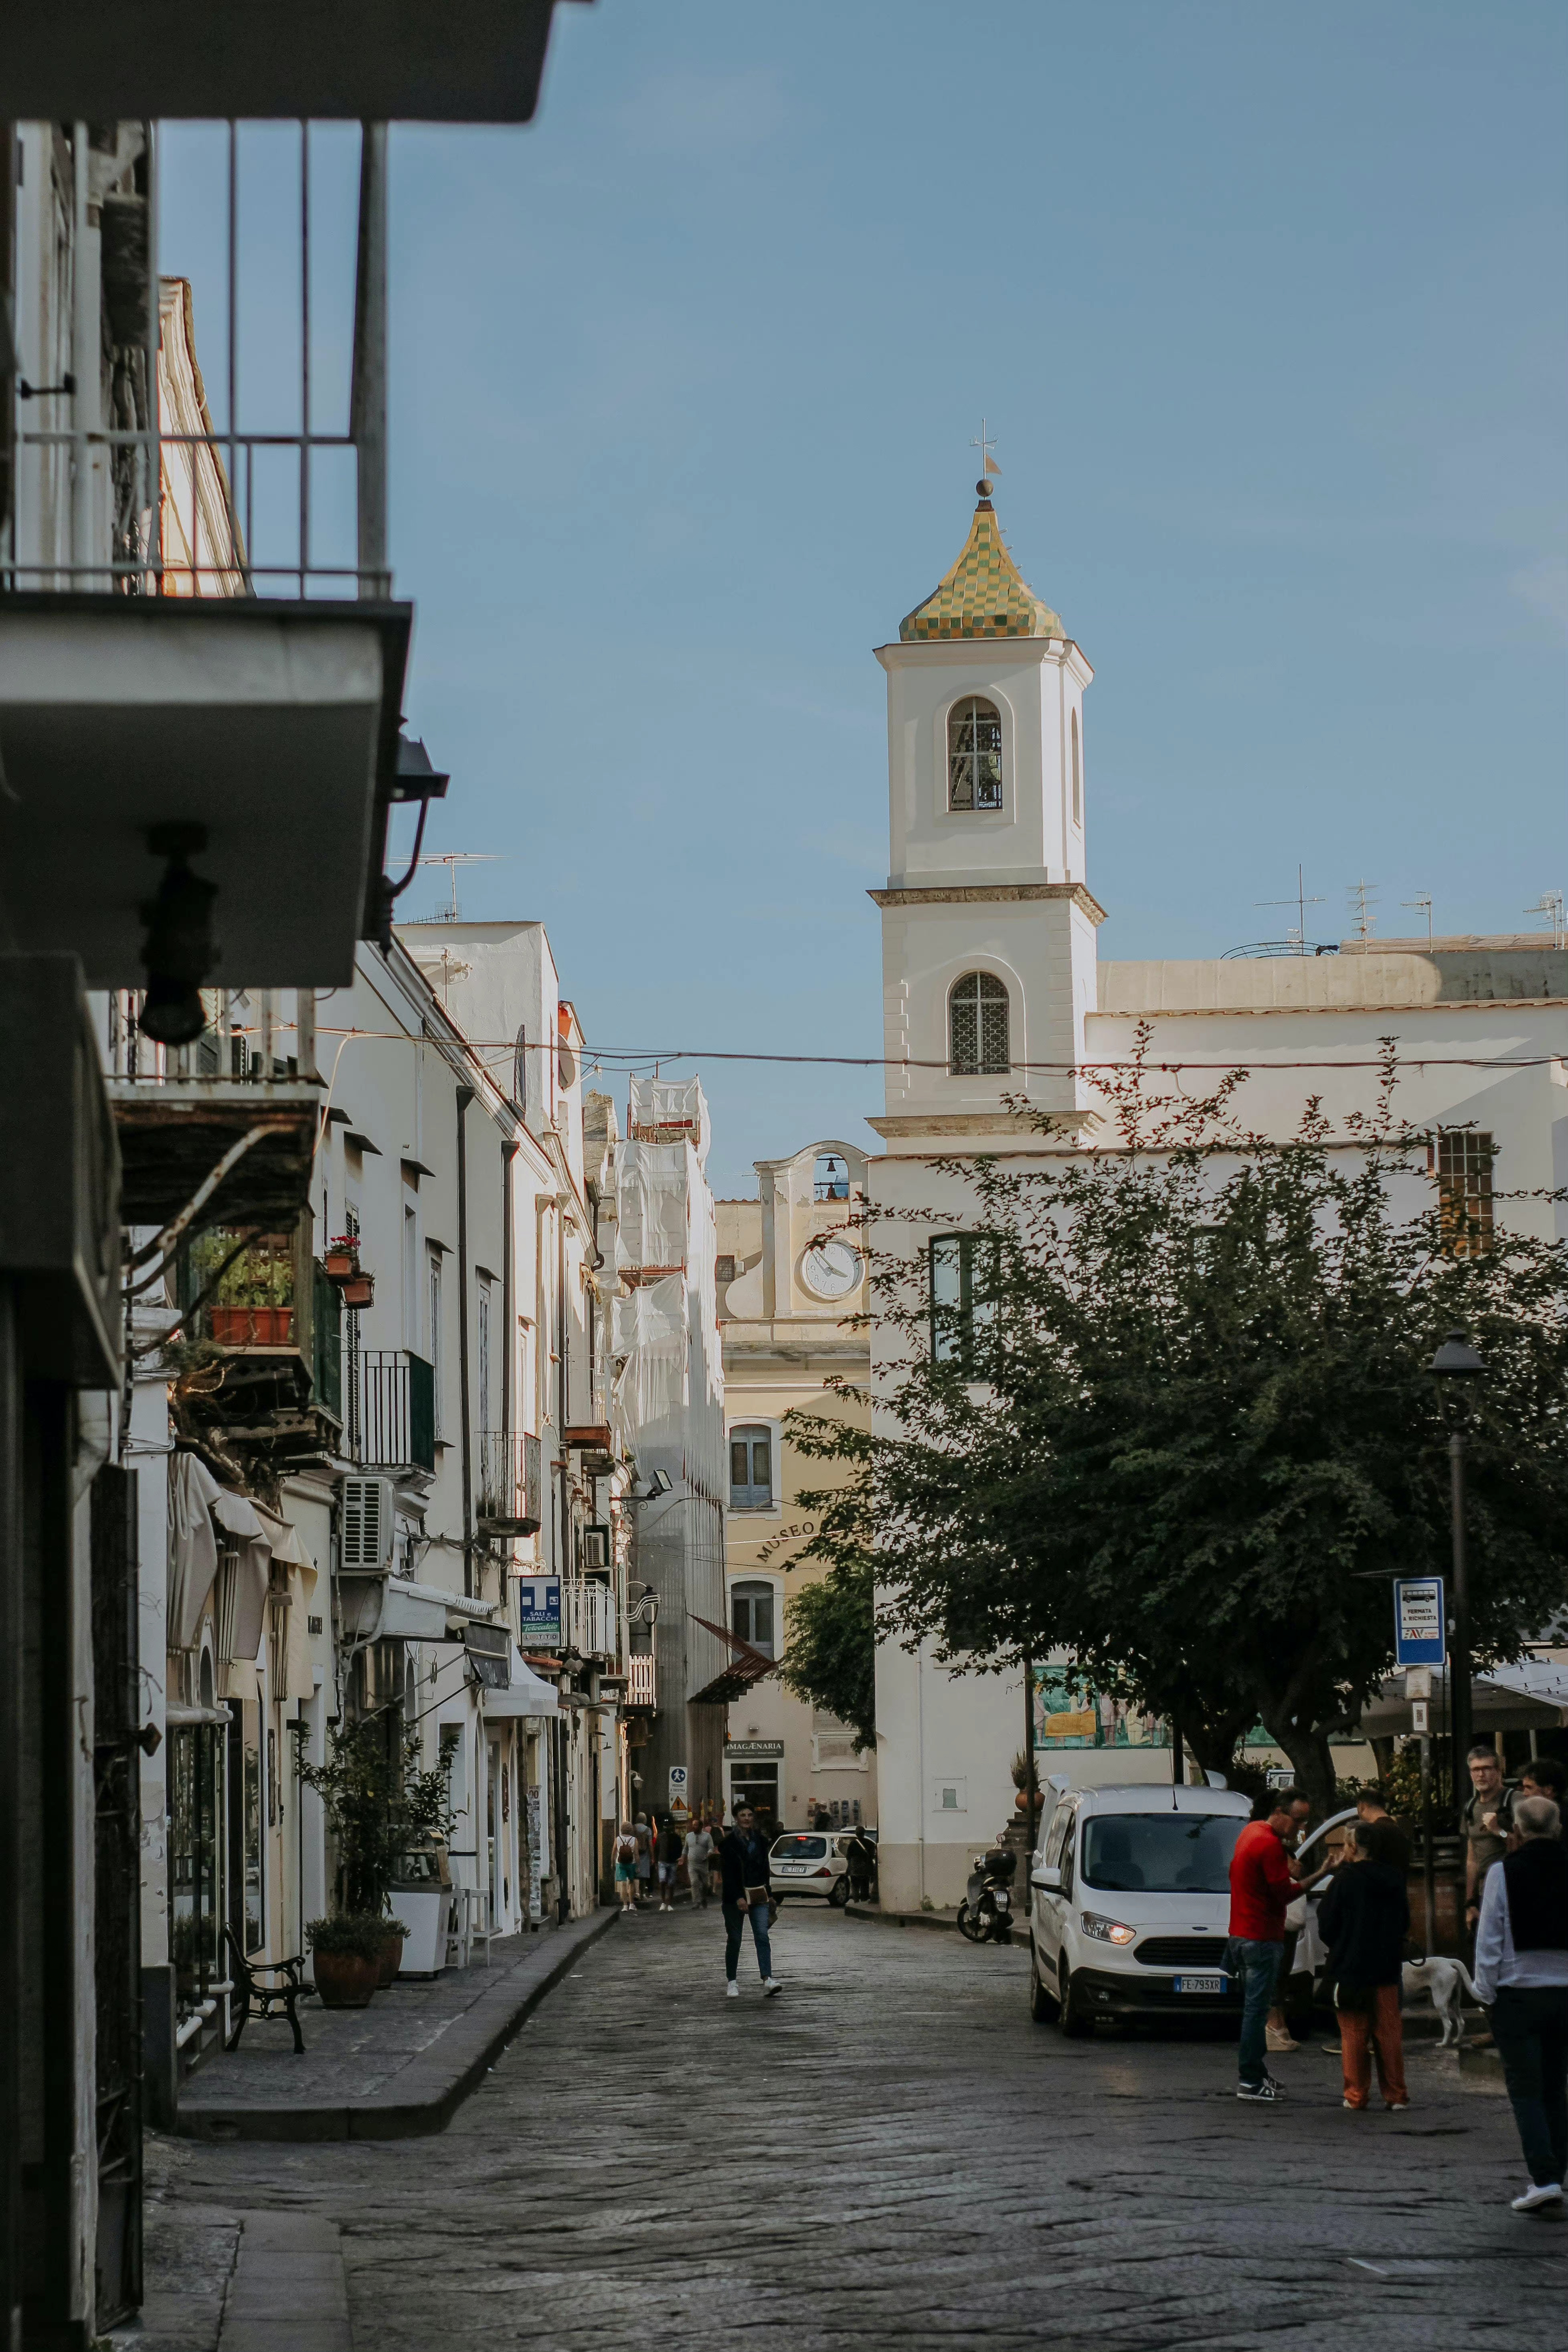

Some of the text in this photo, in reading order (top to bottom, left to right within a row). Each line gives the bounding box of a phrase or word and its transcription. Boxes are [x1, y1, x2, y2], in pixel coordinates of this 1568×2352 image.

[822, 1280, 827, 1288] 7
[756, 1522, 814, 1563] MUSEO
[522, 1577, 558, 1610] T
[523, 1623, 558, 1632] Totocalcio
[1404, 1629, 1424, 1639] EAV
